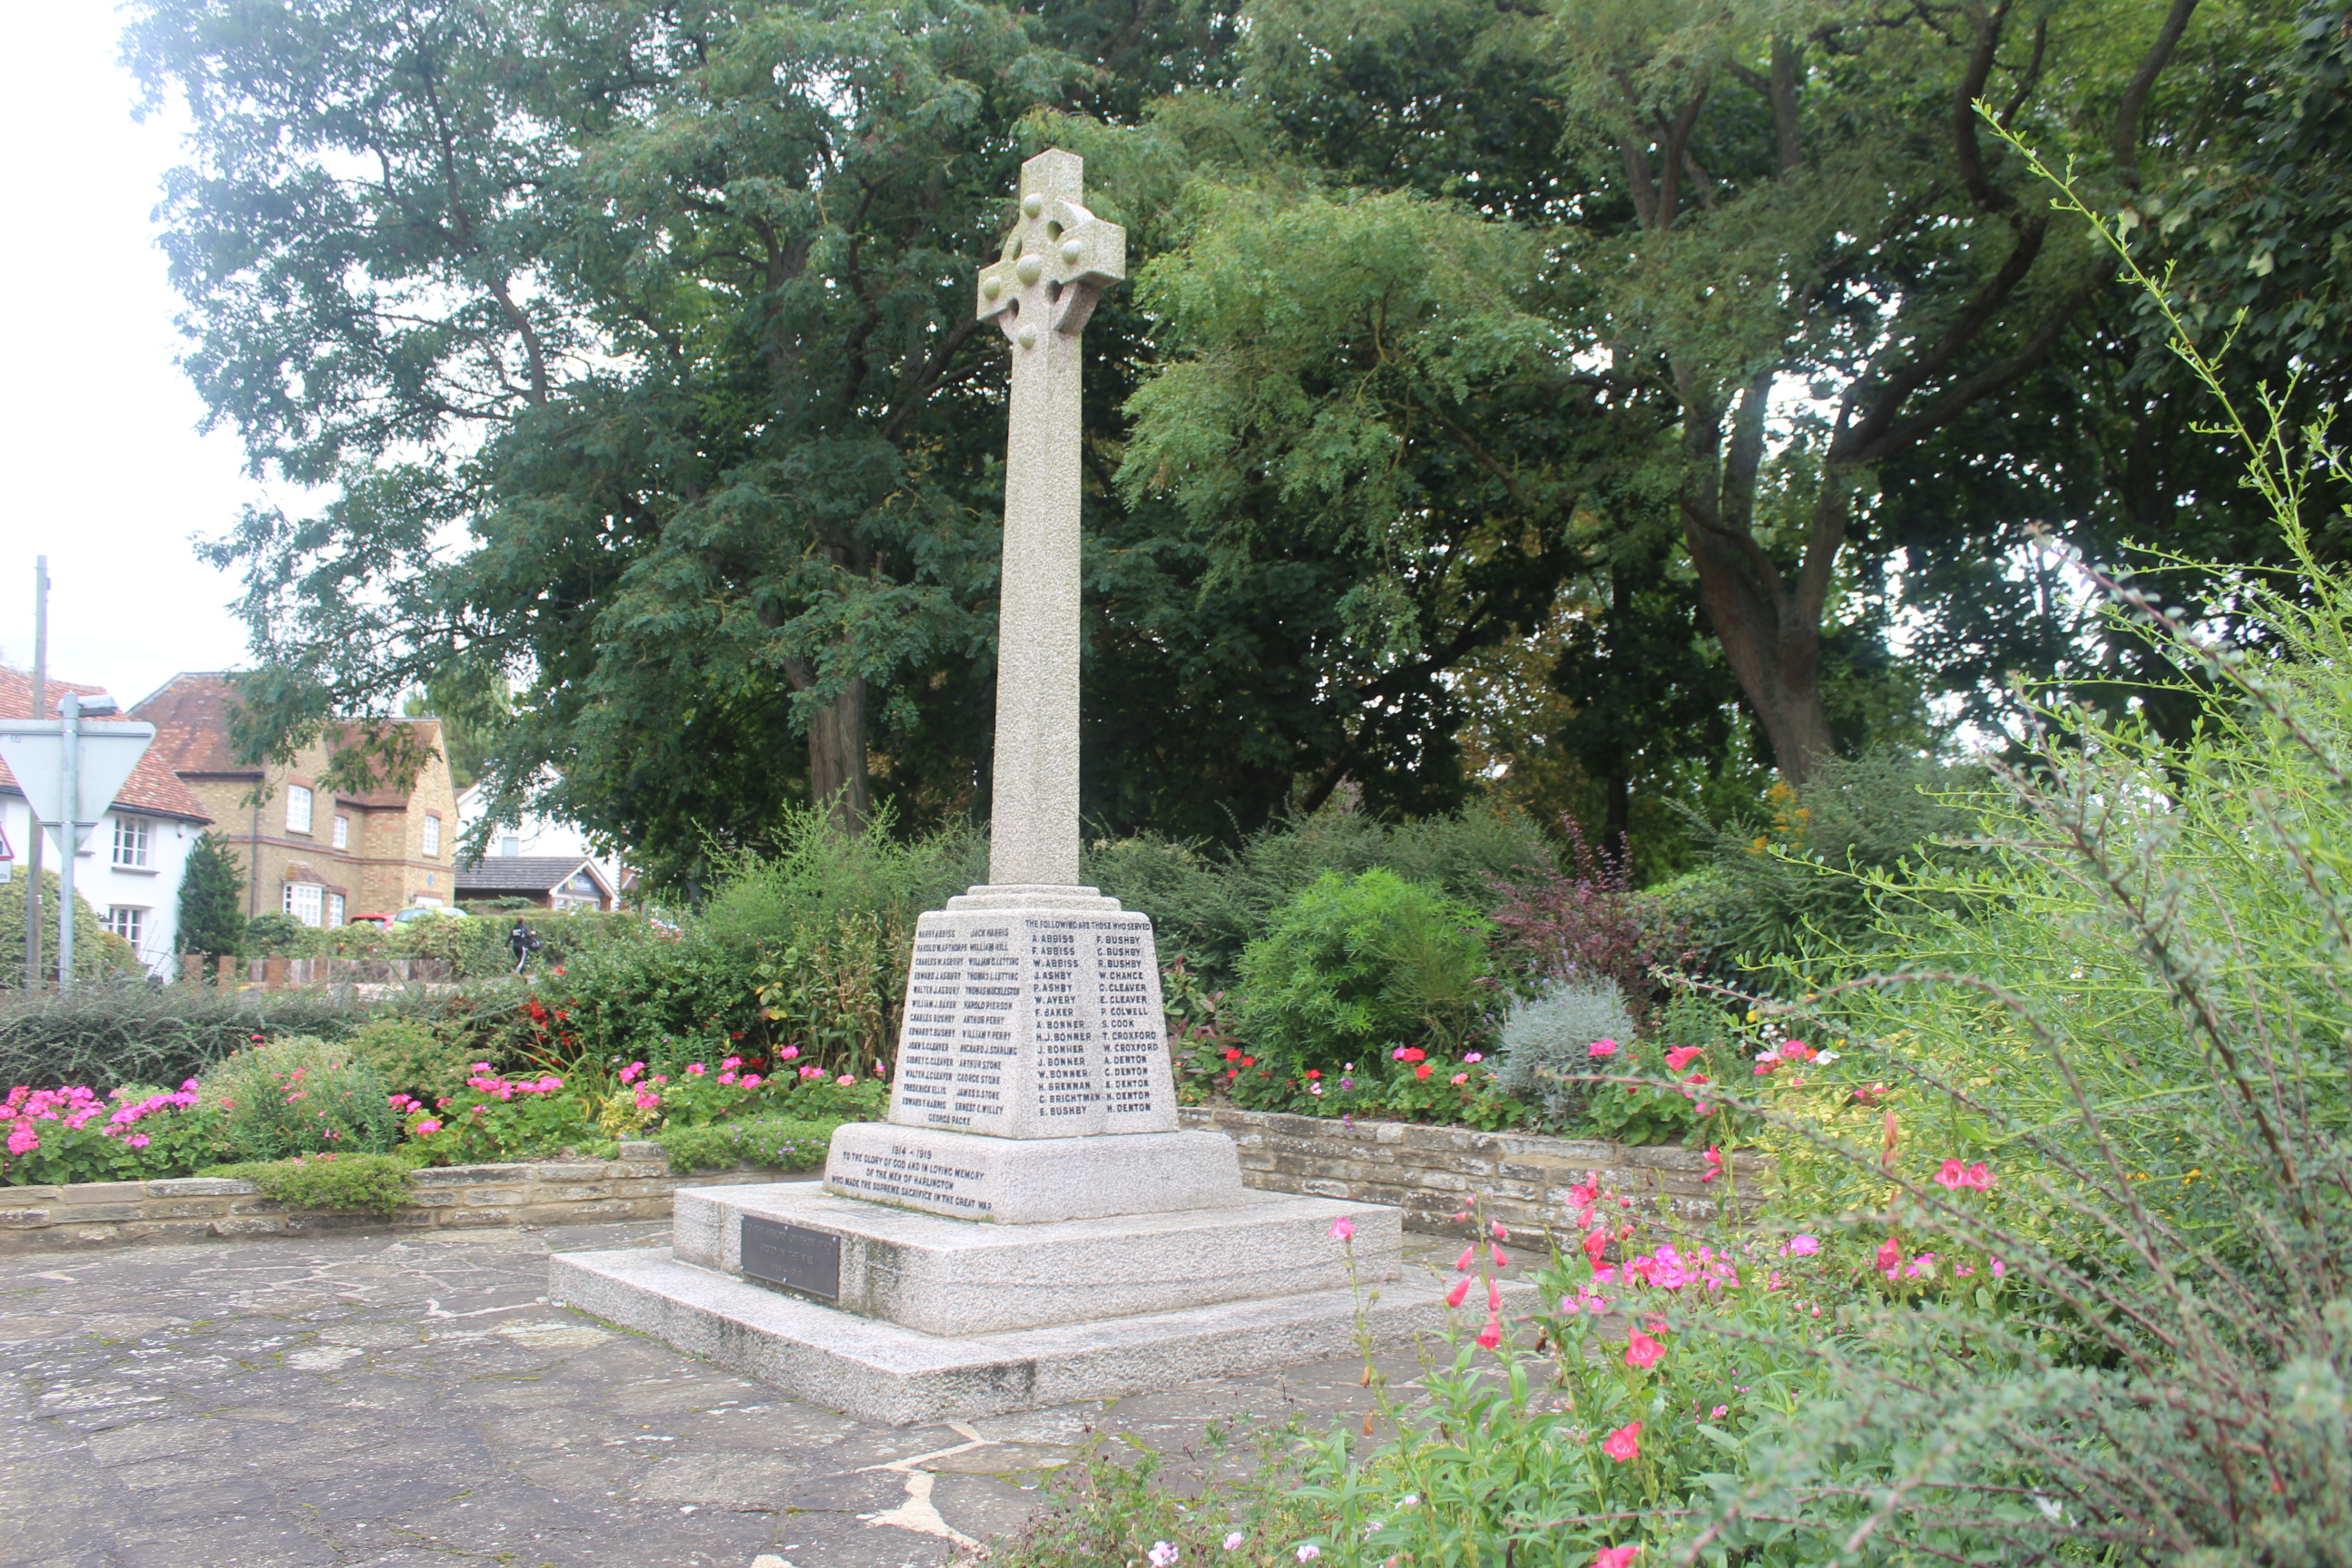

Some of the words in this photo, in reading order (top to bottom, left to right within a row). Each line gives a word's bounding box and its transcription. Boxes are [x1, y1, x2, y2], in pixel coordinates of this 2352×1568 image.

[1040, 920, 1077, 929] FOLLOWING
[986, 928, 1009, 936] HARRIS
[965, 986, 985, 995] THOMAS
[985, 1002, 1013, 1010] PIERSON
[910, 1014, 932, 1022] CHARLES
[934, 1014, 956, 1023] BUSHBY
[964, 1015, 985, 1024] ARTHUR
[985, 1016, 1005, 1024] PERRY
[909, 1027, 928, 1035] EDWARD
[963, 1030, 985, 1039] WILLIAM
[960, 1044, 984, 1054] RICHARD
[959, 1059, 982, 1068] ARTHUR
[982, 1061, 1002, 1069] STONE
[906, 1070, 925, 1078] WALTER
[957, 1073, 979, 1083] GEORGE
[981, 1075, 1000, 1084] STONE
[904, 1083, 931, 1093] FREDERICK
[932, 1086, 946, 1094] ELLIS
[956, 1089, 975, 1097] JAMES
[902, 1097, 921, 1106] EDWARD
[956, 1102, 975, 1112] ERNEST
[928, 1113, 950, 1123] GEORGE
[952, 1116, 971, 1125] PACKE
[892, 1146, 906, 1155] 1914
[916, 1150, 932, 1159] 1919
[843, 1152, 850, 1161] TO
[852, 1153, 862, 1161] THE
[864, 1155, 883, 1165] GLORY
[884, 1158, 892, 1167] OF
[893, 1159, 906, 1169] GOD
[907, 1161, 920, 1171] AND
[922, 1163, 928, 1172] IN
[930, 1165, 953, 1176] LOVING
[955, 1169, 985, 1181] MEMORY
[866, 1168, 874, 1176] OF
[877, 1170, 887, 1179] THE
[888, 1172, 901, 1181] MEN
[904, 1174, 912, 1183] OF
[914, 1175, 954, 1191] HARLINGTON
[831, 1175, 844, 1184] WHO
[845, 1177, 859, 1188] MADE
[861, 1180, 871, 1189] THE
[873, 1181, 899, 1195] SUPREME
[901, 1187, 932, 1200] SACRIFICE
[934, 1192, 940, 1201] IN
[942, 1194, 954, 1204] THE
[955, 1196, 975, 1209] GREAT
